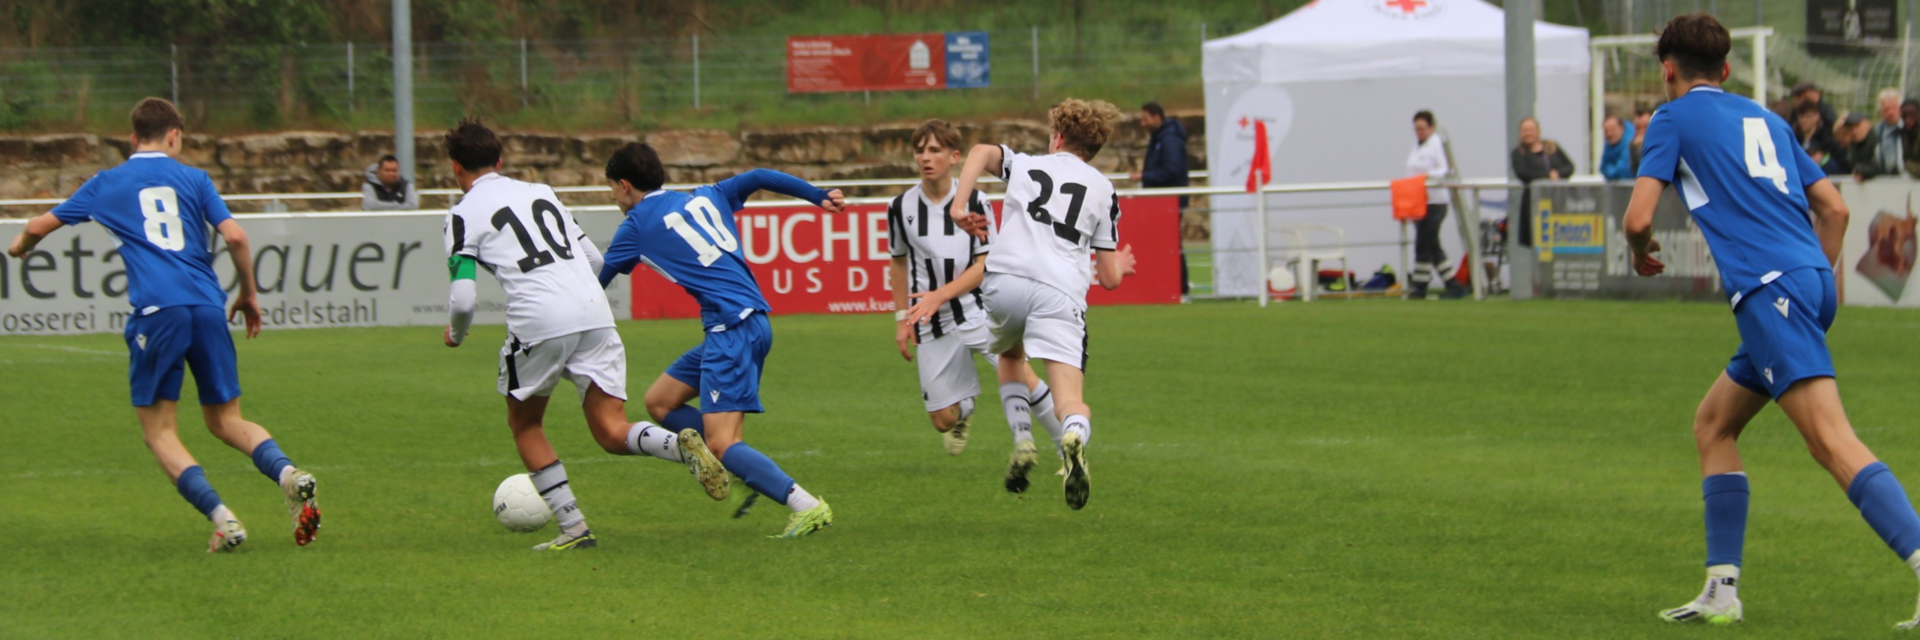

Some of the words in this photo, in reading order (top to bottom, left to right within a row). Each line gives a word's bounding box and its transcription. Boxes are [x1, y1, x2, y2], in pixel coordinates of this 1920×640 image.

[1743, 118, 1790, 195] 4
[138, 186, 186, 252] 8
[491, 198, 575, 273] 10
[663, 196, 738, 268] 10
[736, 212, 890, 264] ÜCHE
[1027, 169, 1088, 246] 21
